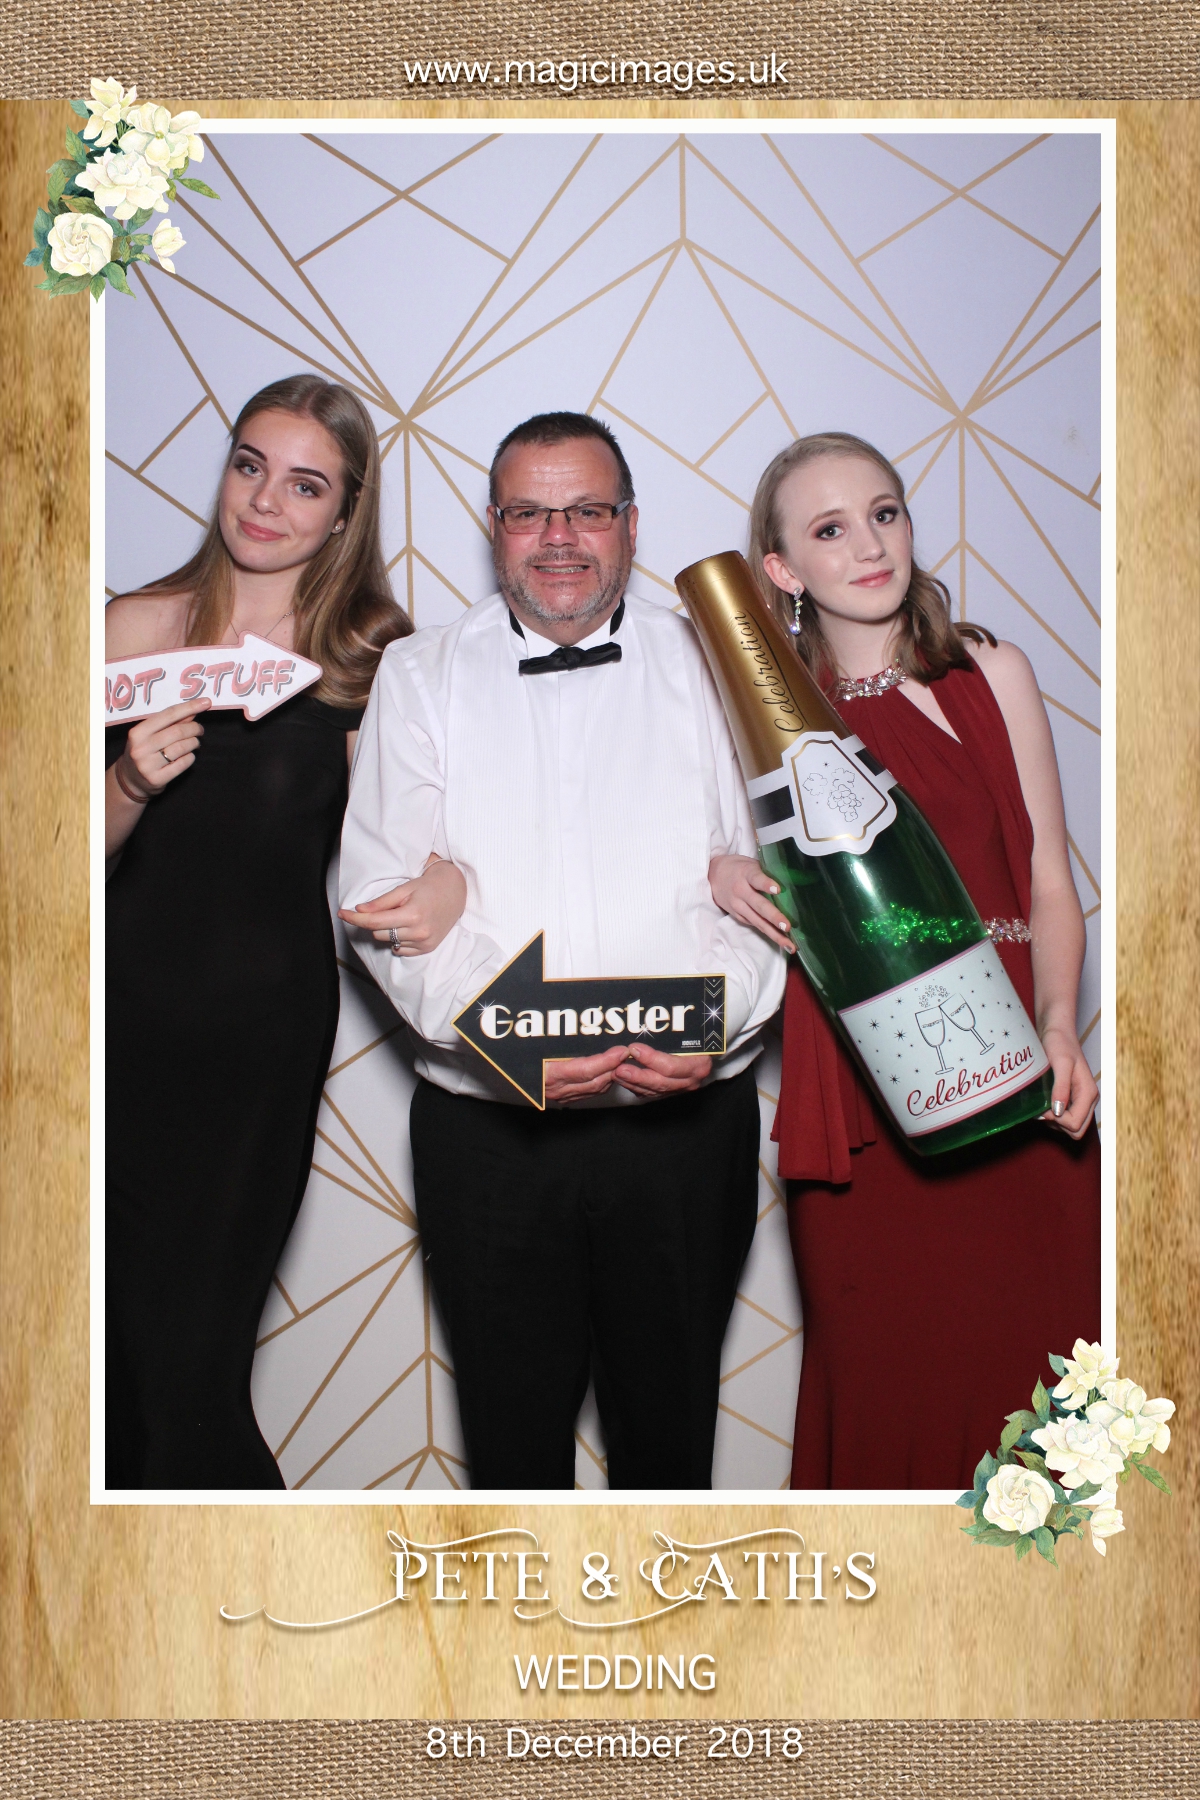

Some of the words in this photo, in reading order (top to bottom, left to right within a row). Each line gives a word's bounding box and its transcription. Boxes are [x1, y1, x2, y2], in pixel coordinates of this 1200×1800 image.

[179, 659, 296, 701] STUFF
[734, 609, 804, 733] Celebration
[480, 999, 695, 1040] Gangster
[906, 1045, 1034, 1117] Celebration
